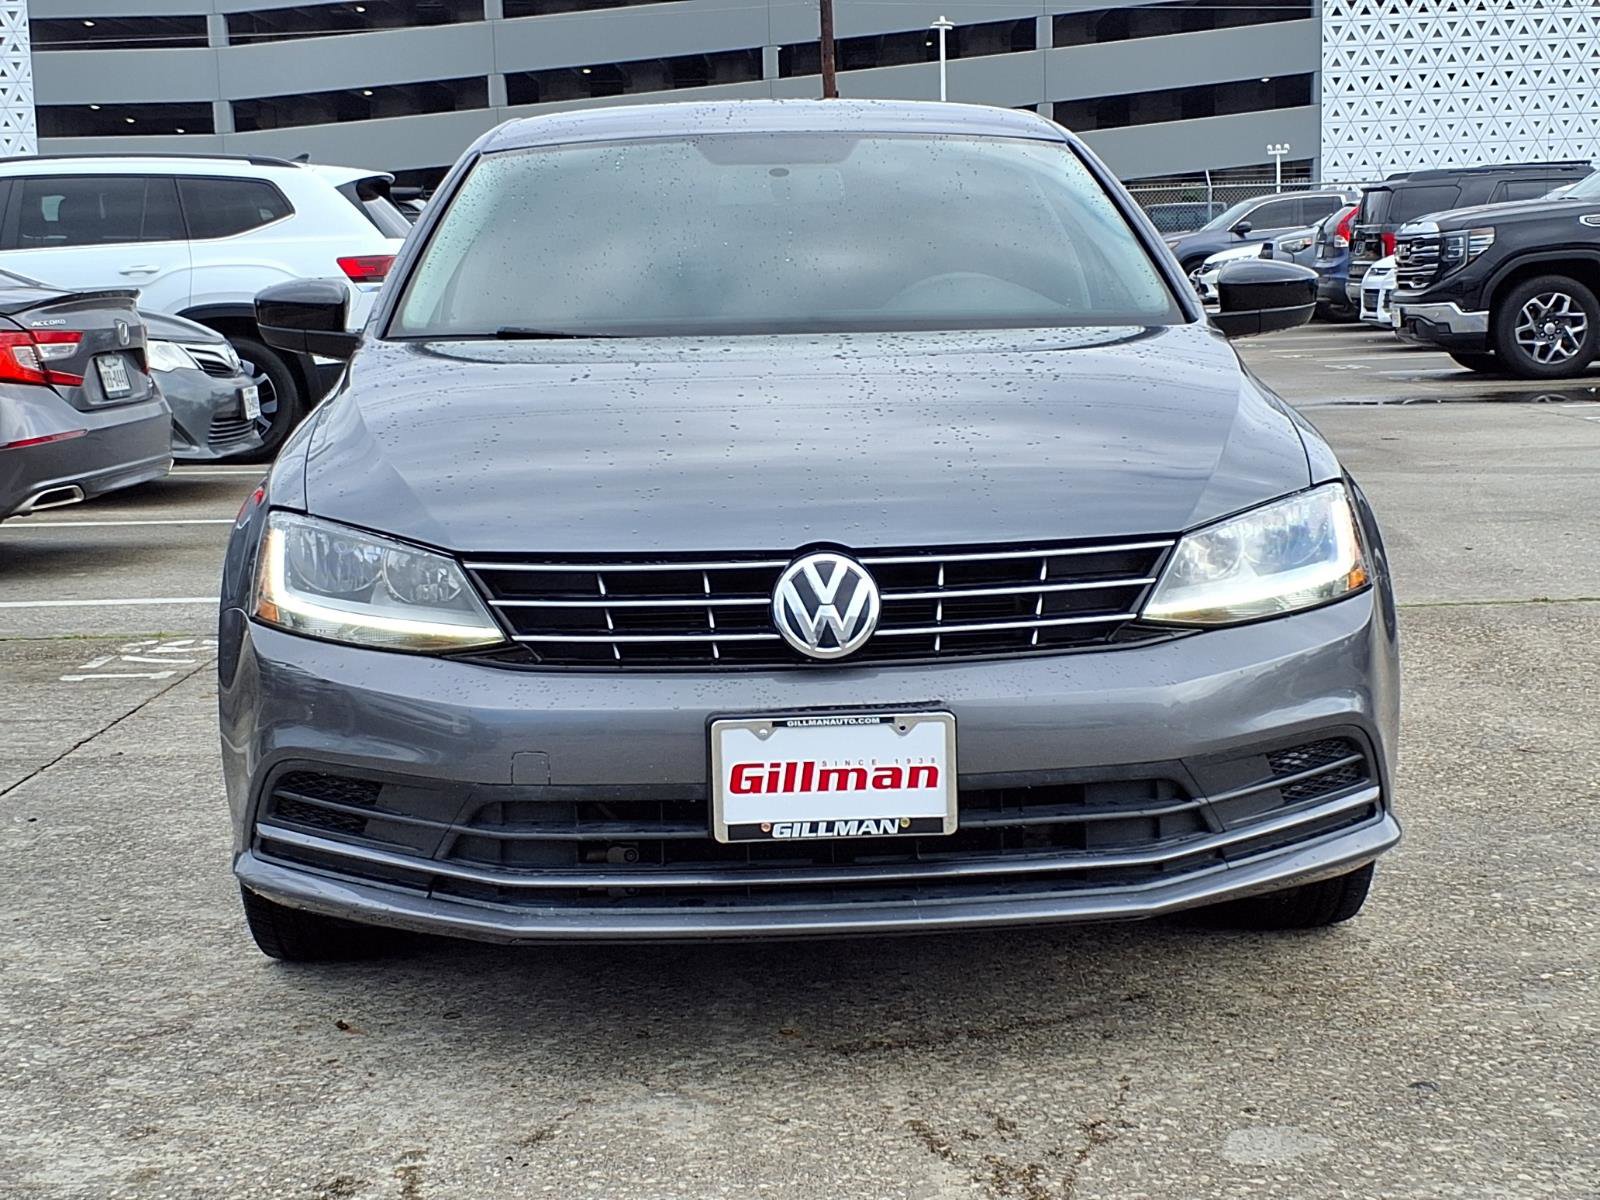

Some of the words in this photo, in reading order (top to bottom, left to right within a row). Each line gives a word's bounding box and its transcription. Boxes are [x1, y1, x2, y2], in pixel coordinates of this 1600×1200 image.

[31, 319, 66, 327] ACCORD
[787, 717, 880, 727] GILLMANAUTO.COM
[822, 759, 877, 767] SINCE
[729, 761, 939, 795] Gillman
[772, 819, 899, 838] GILLMAN
